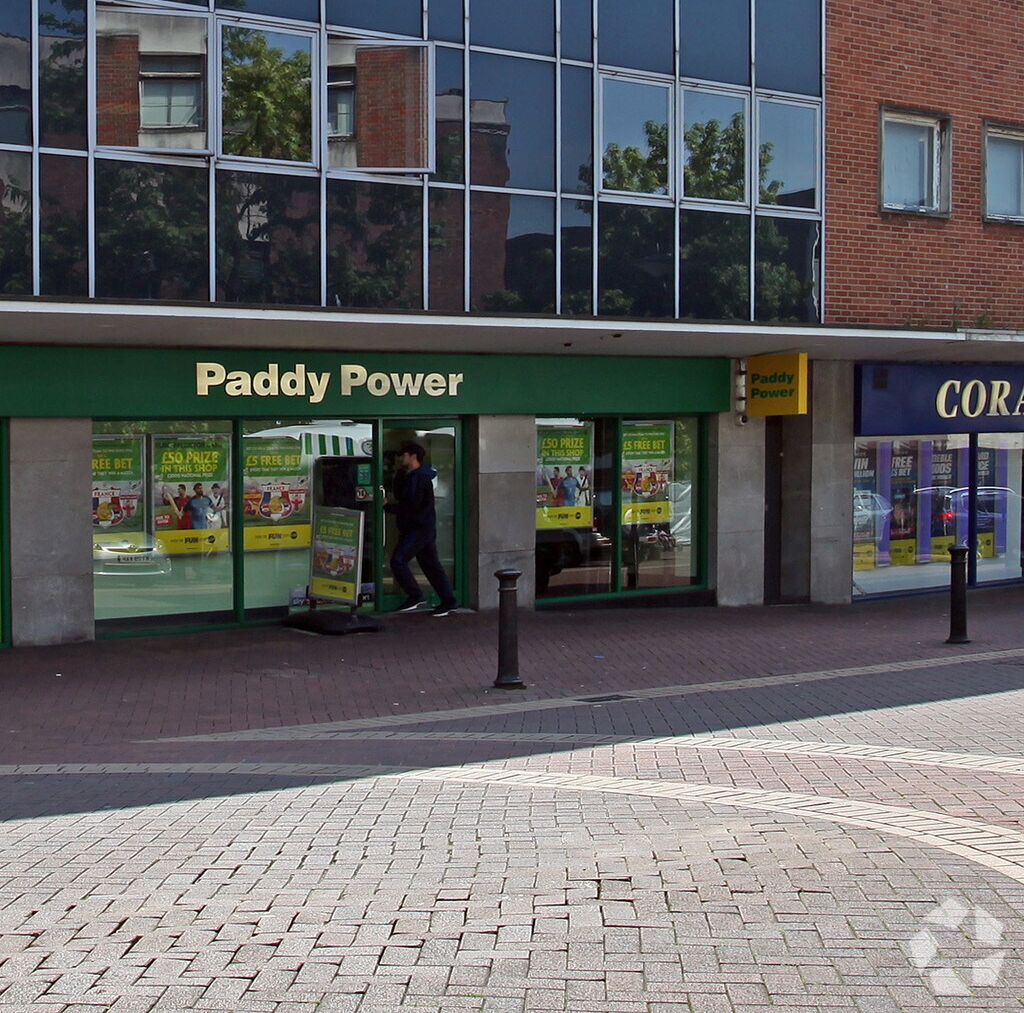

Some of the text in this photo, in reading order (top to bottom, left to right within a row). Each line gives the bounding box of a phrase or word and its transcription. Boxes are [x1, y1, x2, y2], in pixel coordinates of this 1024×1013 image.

[196, 363, 463, 403] Paddy Power
[751, 372, 796, 399] Paddy Power
[542, 438, 584, 448] £50 PRIZE
[634, 440, 651, 450] FREE
[653, 440, 666, 449] BET
[92, 458, 133, 470] REE BET
[162, 451, 219, 464] £50 PRIZE
[247, 454, 302, 467] £5 FREE BET
[892, 456, 914, 469] FREE
[162, 463, 218, 473] IN THIS SHOP
